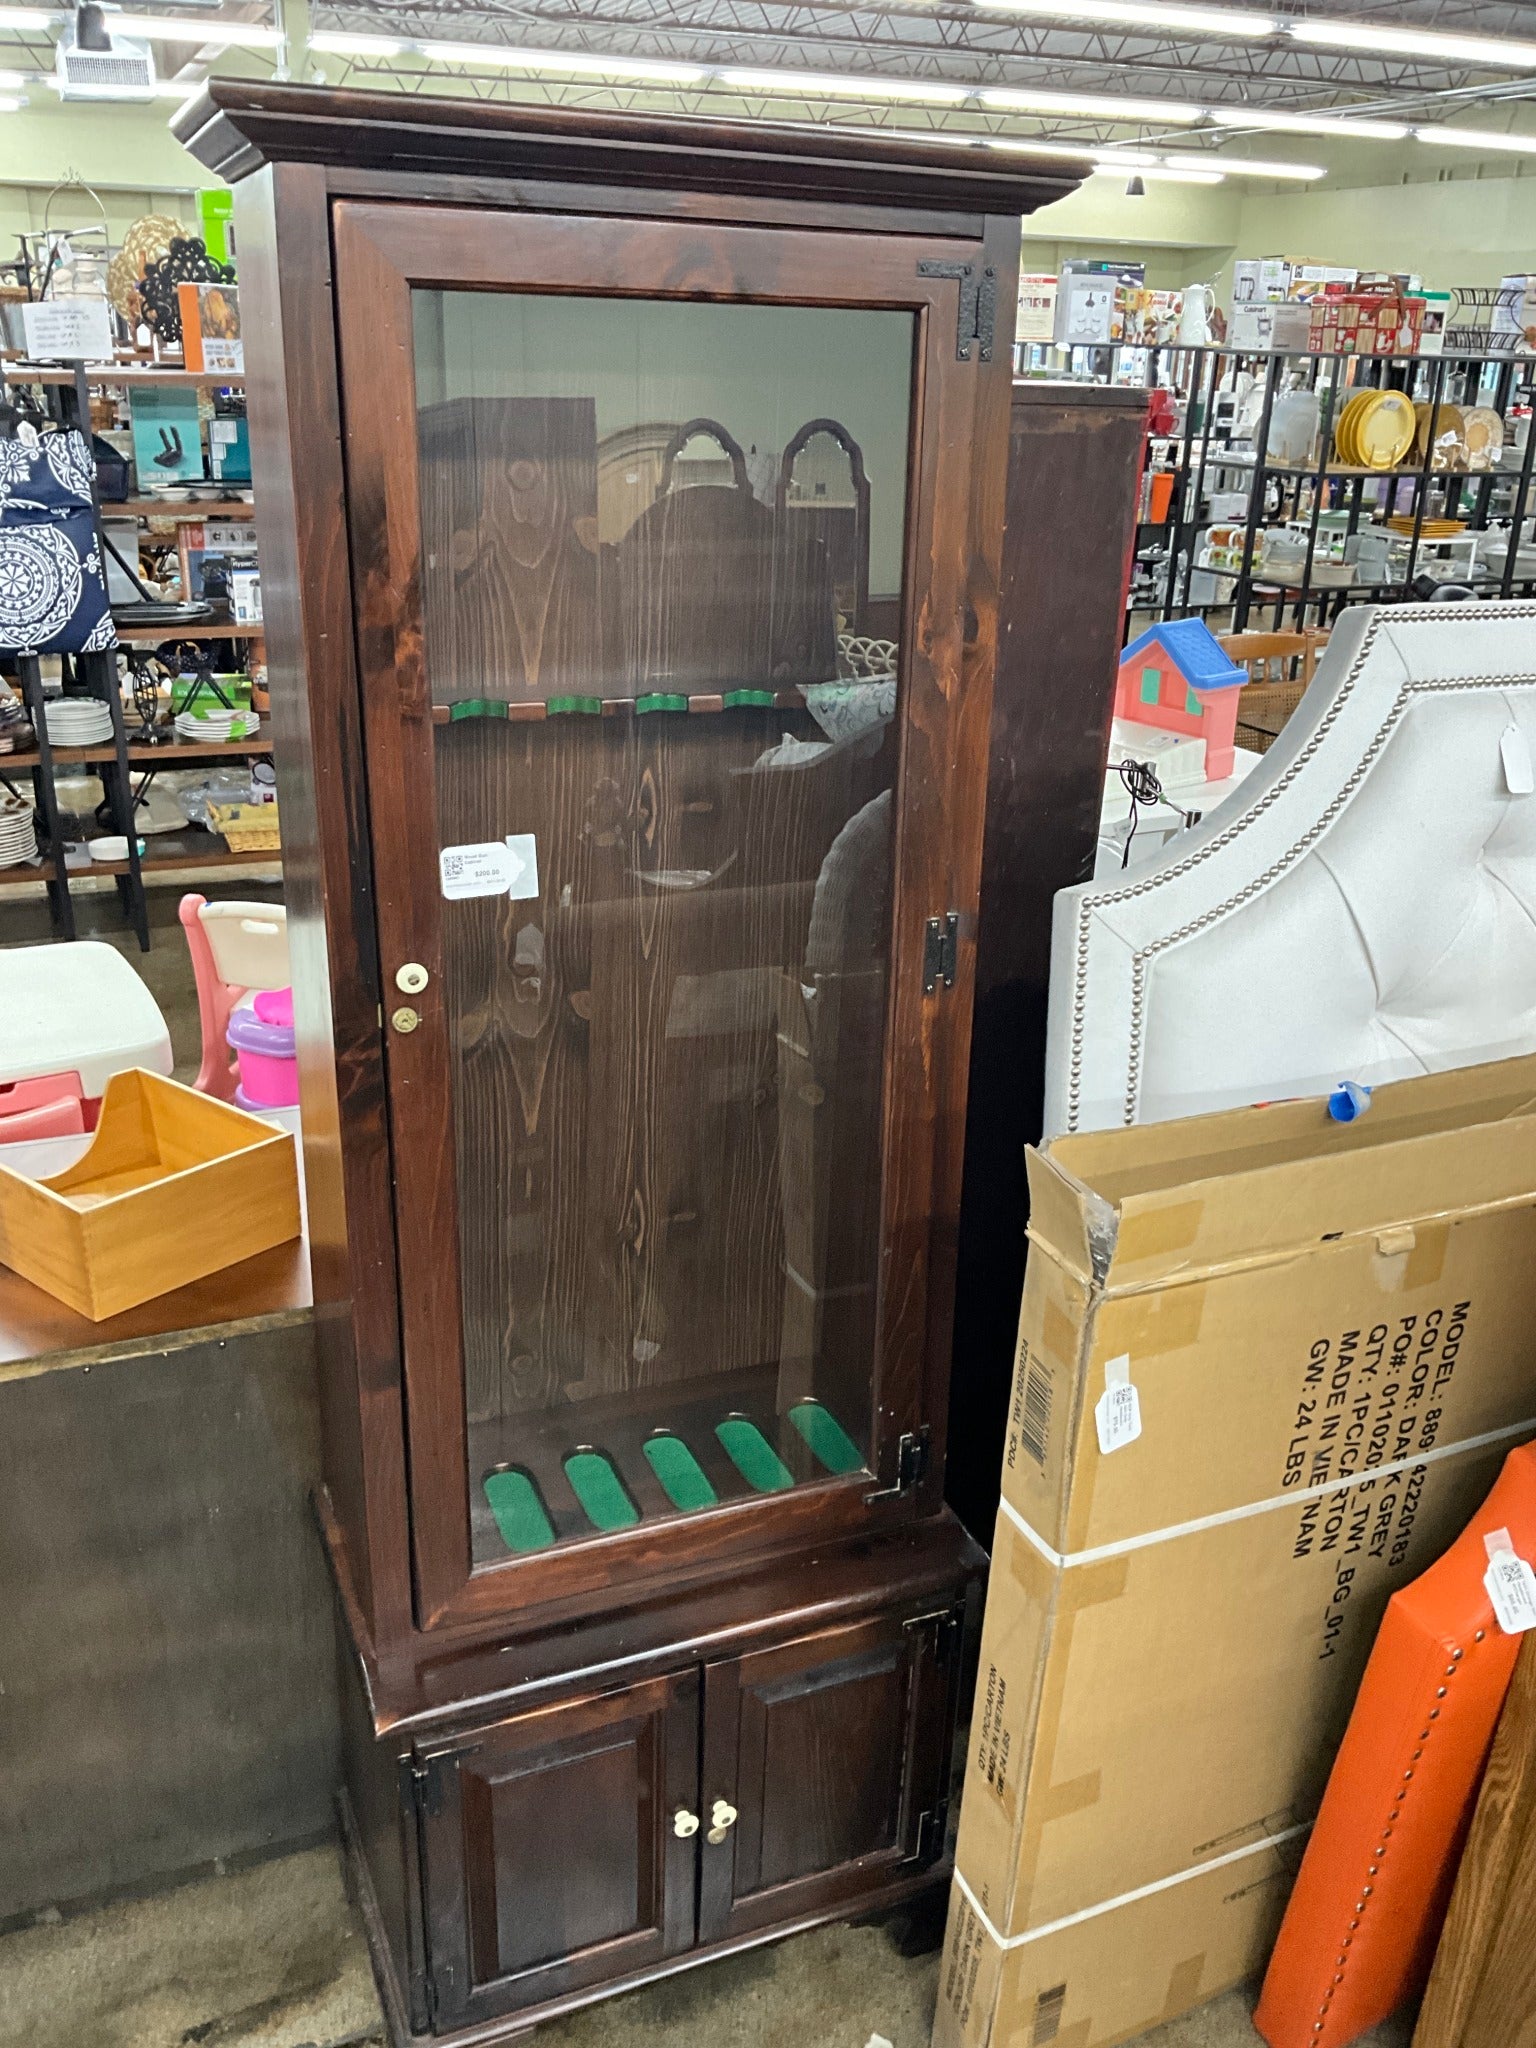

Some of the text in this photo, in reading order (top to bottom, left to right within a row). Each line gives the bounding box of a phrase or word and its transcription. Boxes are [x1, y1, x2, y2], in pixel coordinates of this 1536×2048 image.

[1326, 1330, 1361, 1409] MADE
[1386, 1315, 1417, 1376] PO#:
[1403, 1309, 1443, 1410] COLOR:
[1282, 1338, 1331, 1487] GW: 24 LBS
[1319, 1414, 1341, 1441] IN
[1320, 1324, 1388, 1552] QTY: 1PC/CARTON
[1389, 1301, 1471, 1567] MODEL: 88942220183
[1368, 1494, 1396, 1559] GREY
[987, 1749, 998, 1785] MADE
[993, 1676, 1007, 1734] VIETNAM
